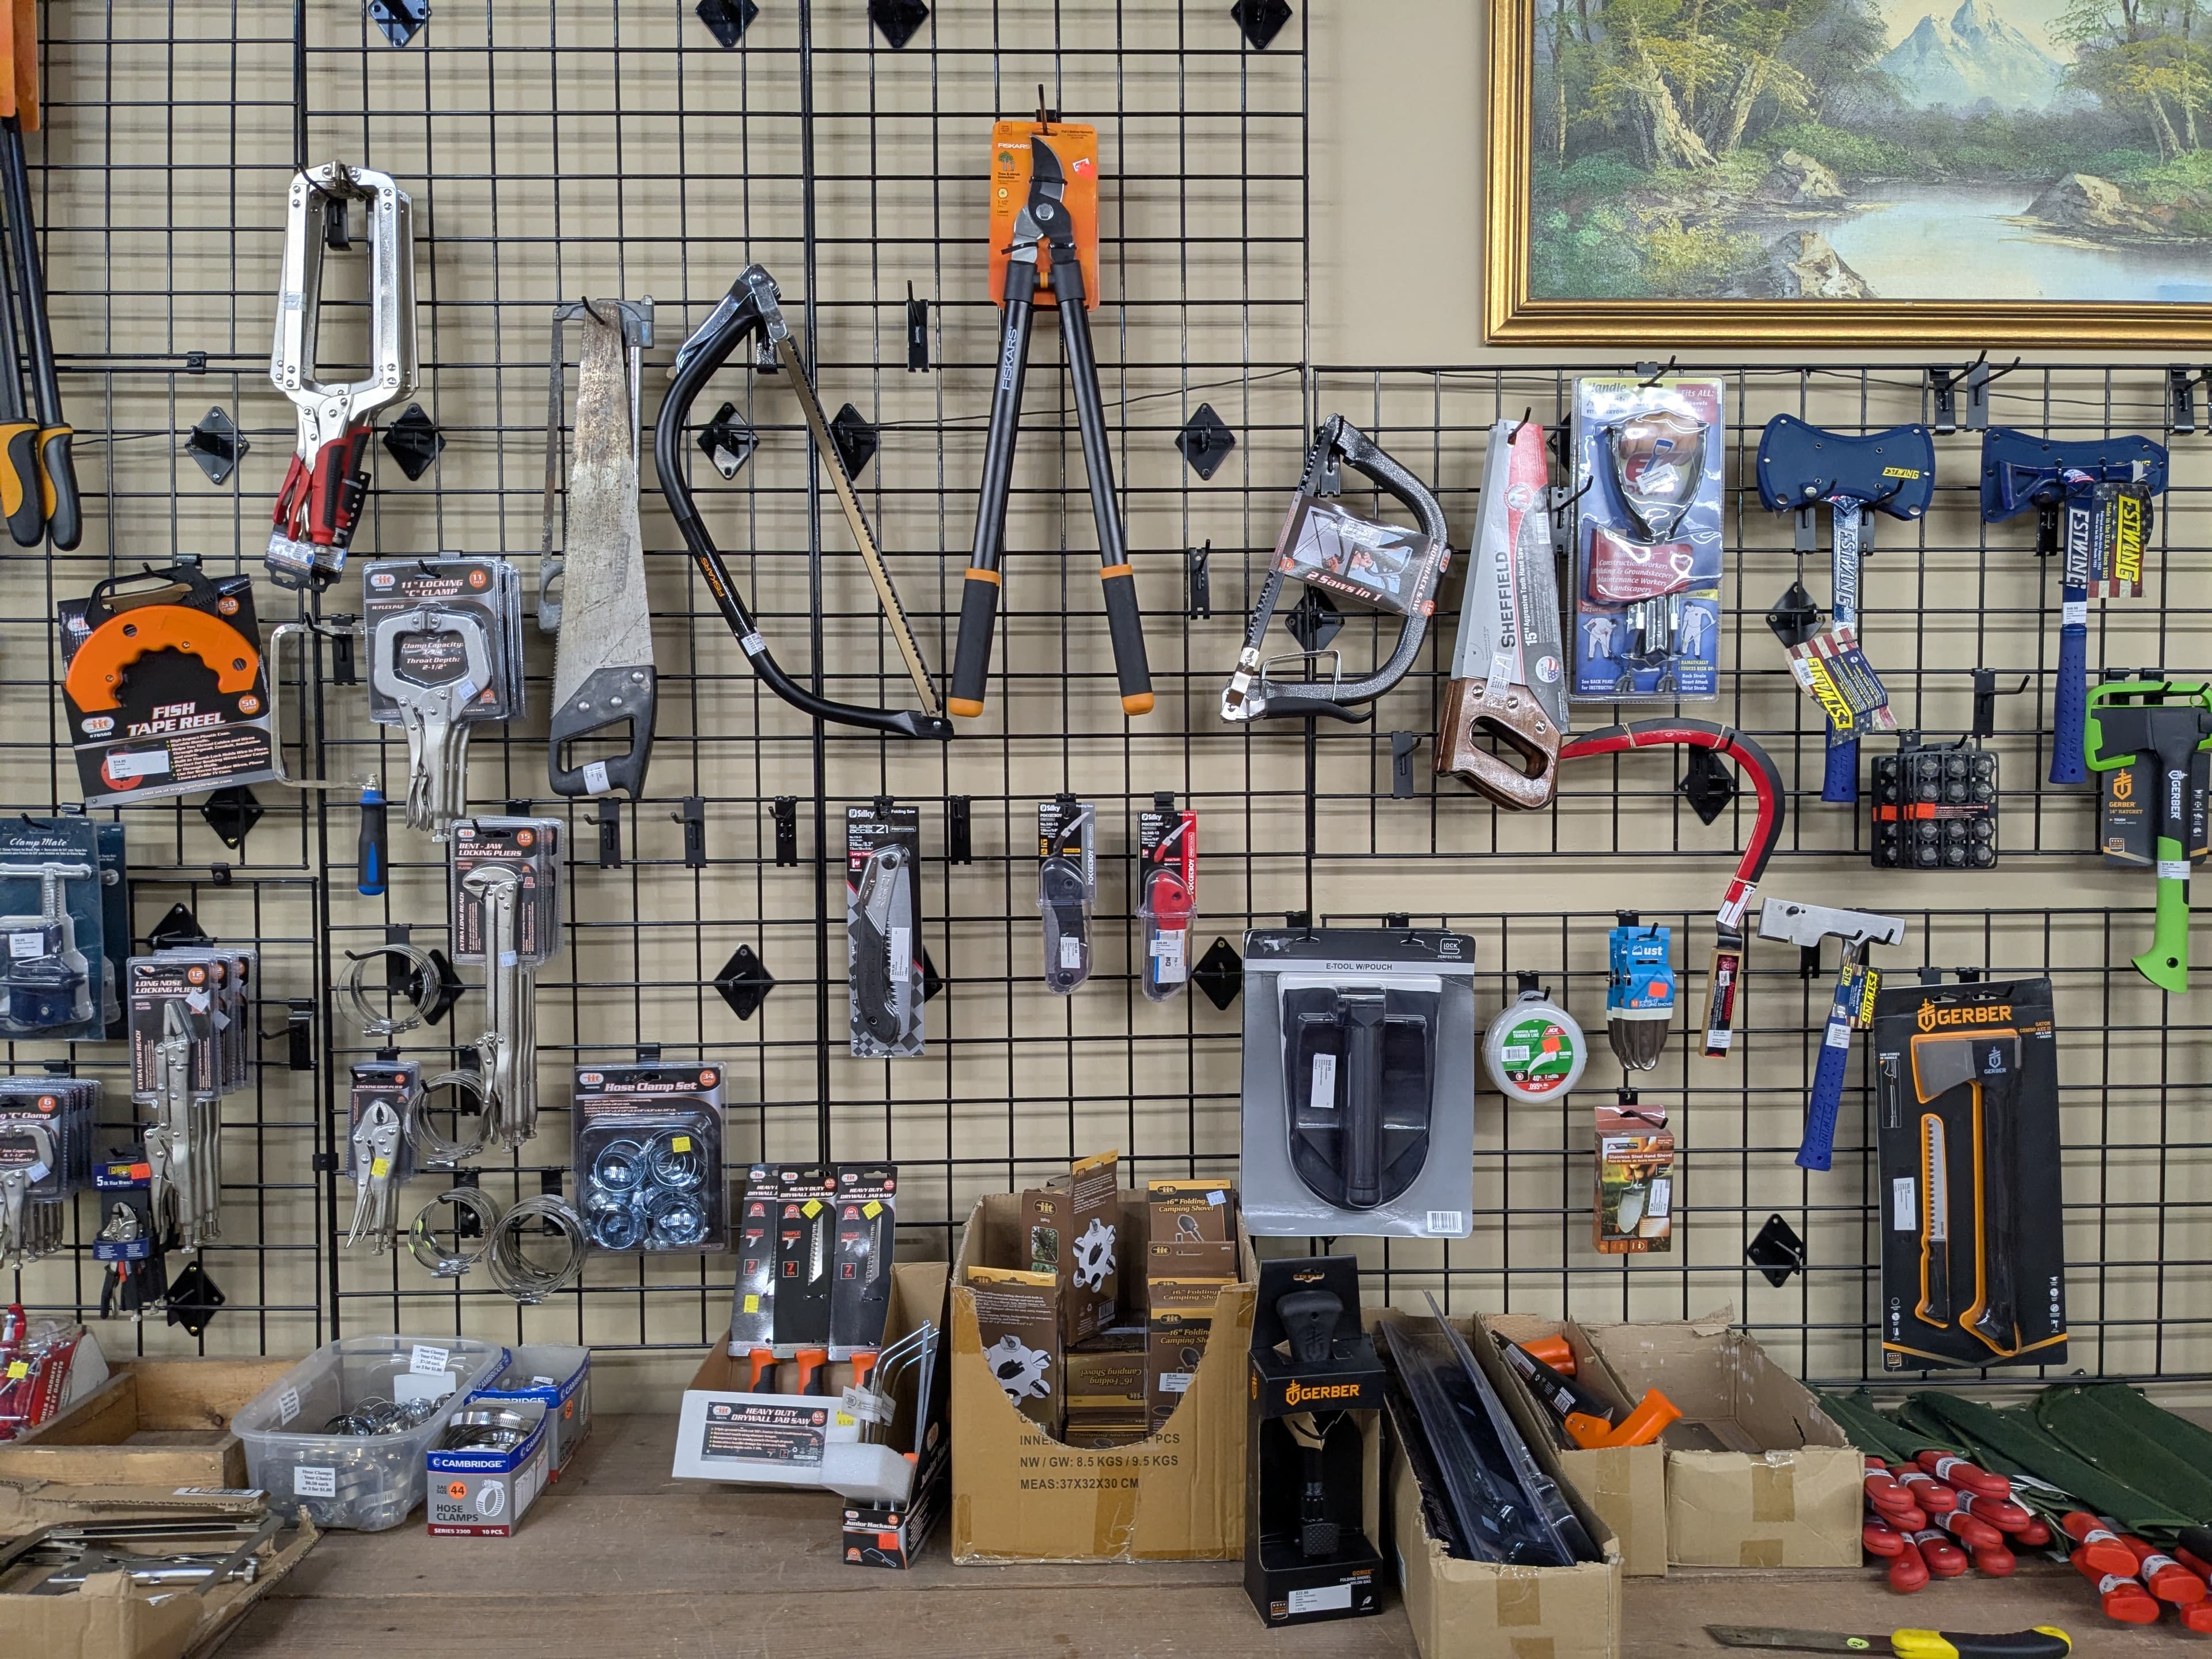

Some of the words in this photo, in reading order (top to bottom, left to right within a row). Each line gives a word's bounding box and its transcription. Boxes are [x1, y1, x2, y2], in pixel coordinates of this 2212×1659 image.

[1002, 329, 1017, 391] FISKARS
[1883, 467, 1919, 479] ESTWING
[2115, 494, 2141, 583] ESTWING
[2066, 506, 2090, 590] ESTWING
[1642, 561, 1668, 570] Workers
[1835, 528, 1856, 609] ESTWING
[700, 557, 725, 597] FISKARS
[1641, 578, 1666, 586] Workers
[419, 579, 463, 588] LOCKING
[1306, 571, 1317, 580] 2
[1318, 574, 1357, 594] Saws
[1356, 588, 1371, 599] in
[1374, 594, 1382, 602] 1
[1518, 577, 1527, 593] Tooth
[1610, 585, 1652, 593] Landscapers
[422, 588, 458, 596] CLAMP
[1495, 552, 1516, 648] SHEFFIELD
[1520, 594, 1530, 626] Aggressive
[242, 699, 257, 707] 50
[152, 702, 196, 719] FISH
[127, 721, 176, 737] TAPE
[180, 713, 226, 729] REEL
[2171, 779, 2181, 820] GERBER
[858, 809, 875, 819] Silky
[10, 838, 40, 848] Clamp
[41, 838, 68, 846] Mate
[1643, 946, 1664, 956] ust
[1861, 971, 1878, 1024] ESTWING
[1937, 1005, 2013, 1025] GERBER
[605, 1083, 635, 1092] Hose
[637, 1082, 673, 1092] Clamp
[675, 1082, 698, 1090] Set
[97, 1176, 104, 1186] 5
[478, 1361, 503, 1391] CAMBRIDGE
[1080, 1368, 1106, 1377] Shovel
[1108, 1368, 1143, 1376] Camping
[1301, 1384, 1360, 1400] GERBER
[1156, 1433, 1180, 1444] PCS
[442, 1459, 502, 1468] CAMBRIDGE
[1020, 1457, 1040, 1467] NW
[1049, 1457, 1073, 1467] GW:
[1077, 1457, 1094, 1467] 8.5
[1097, 1456, 1123, 1467] KGS
[1132, 1456, 1149, 1466] 9.5
[1153, 1455, 1179, 1466] KGS
[1020, 1479, 1118, 1490] MEAS:37X32X30
[1120, 1478, 1139, 1488] CM
[450, 1486, 465, 1495] 44
[437, 1504, 463, 1513] HOSE
[437, 1513, 479, 1522] CLAMPS
